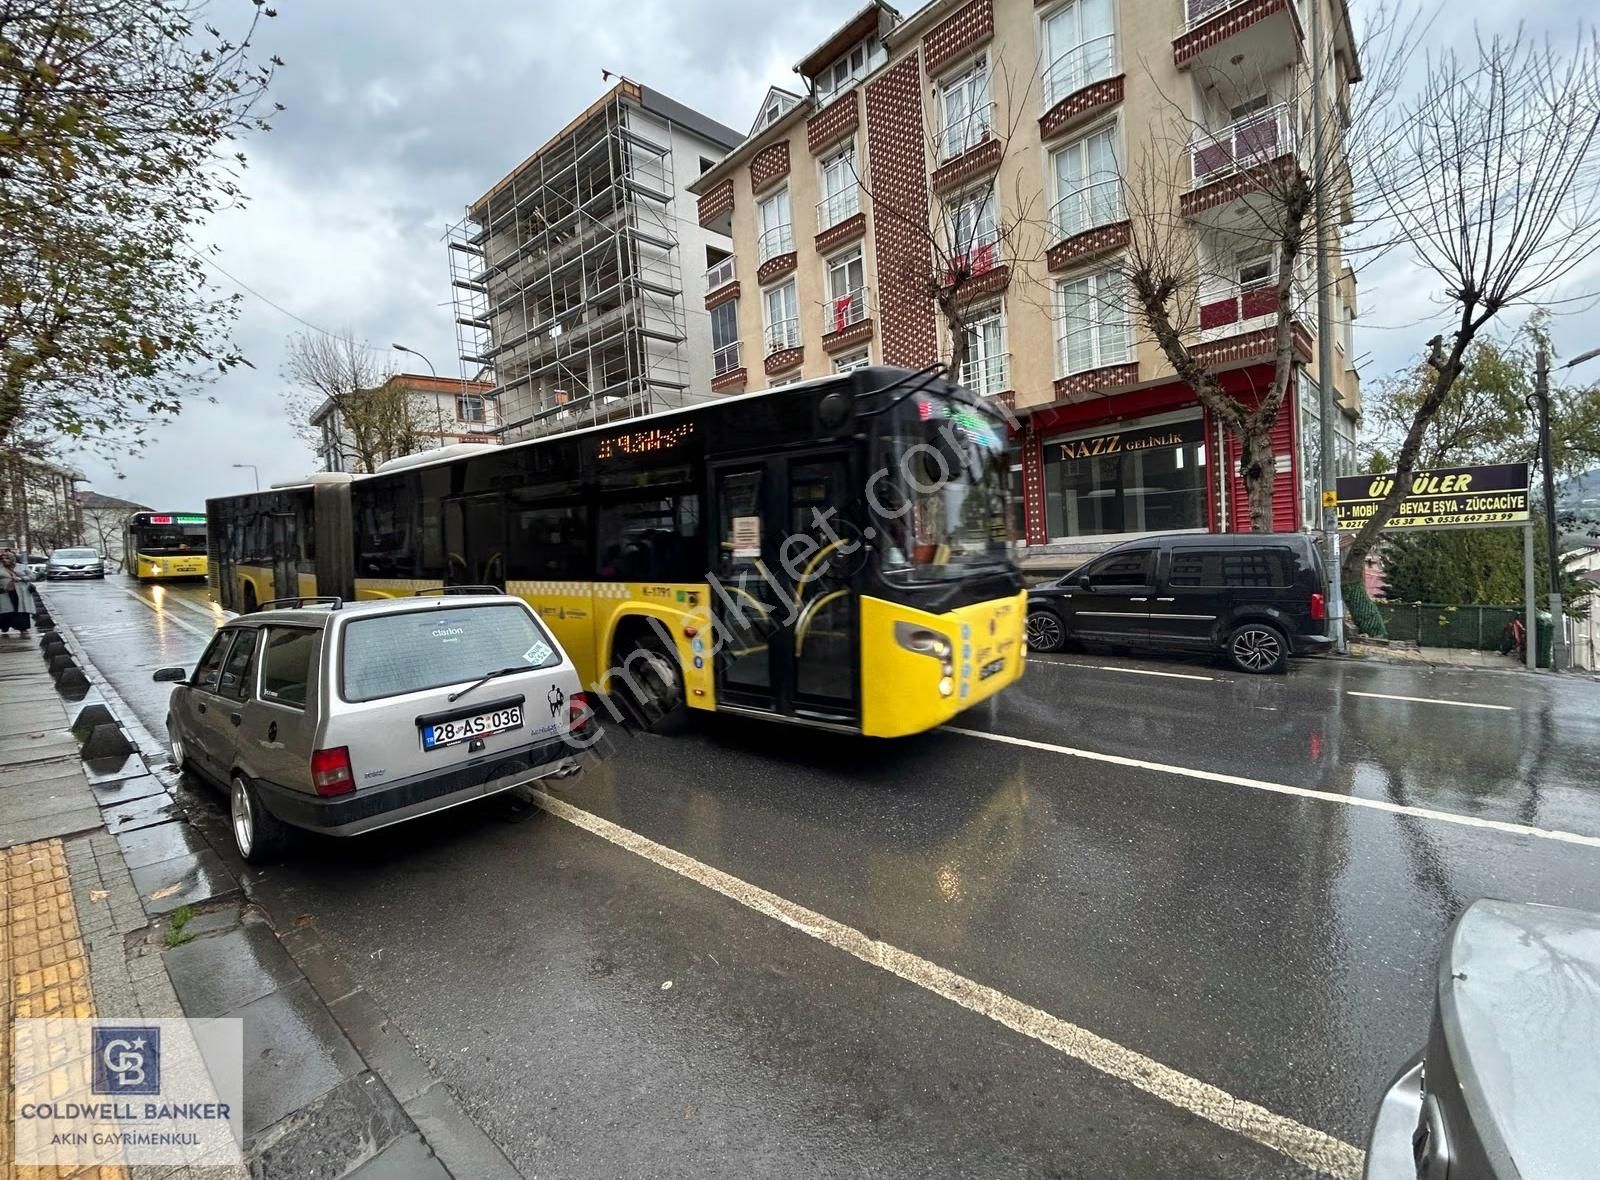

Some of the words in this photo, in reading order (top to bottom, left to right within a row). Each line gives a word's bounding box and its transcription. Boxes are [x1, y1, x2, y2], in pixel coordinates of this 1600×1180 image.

[1060, 435, 1121, 461] NAZZ
[1125, 433, 1183, 450] GELİNLİK
[1400, 501, 1430, 515] BEYAZ
[1432, 500, 1458, 515] EŞYA
[1466, 494, 1525, 511] ZÜCCACİYE
[432, 627, 463, 637] clarion
[434, 724, 456, 744] 28
[463, 716, 485, 736] AS
[491, 708, 519, 728] 036
